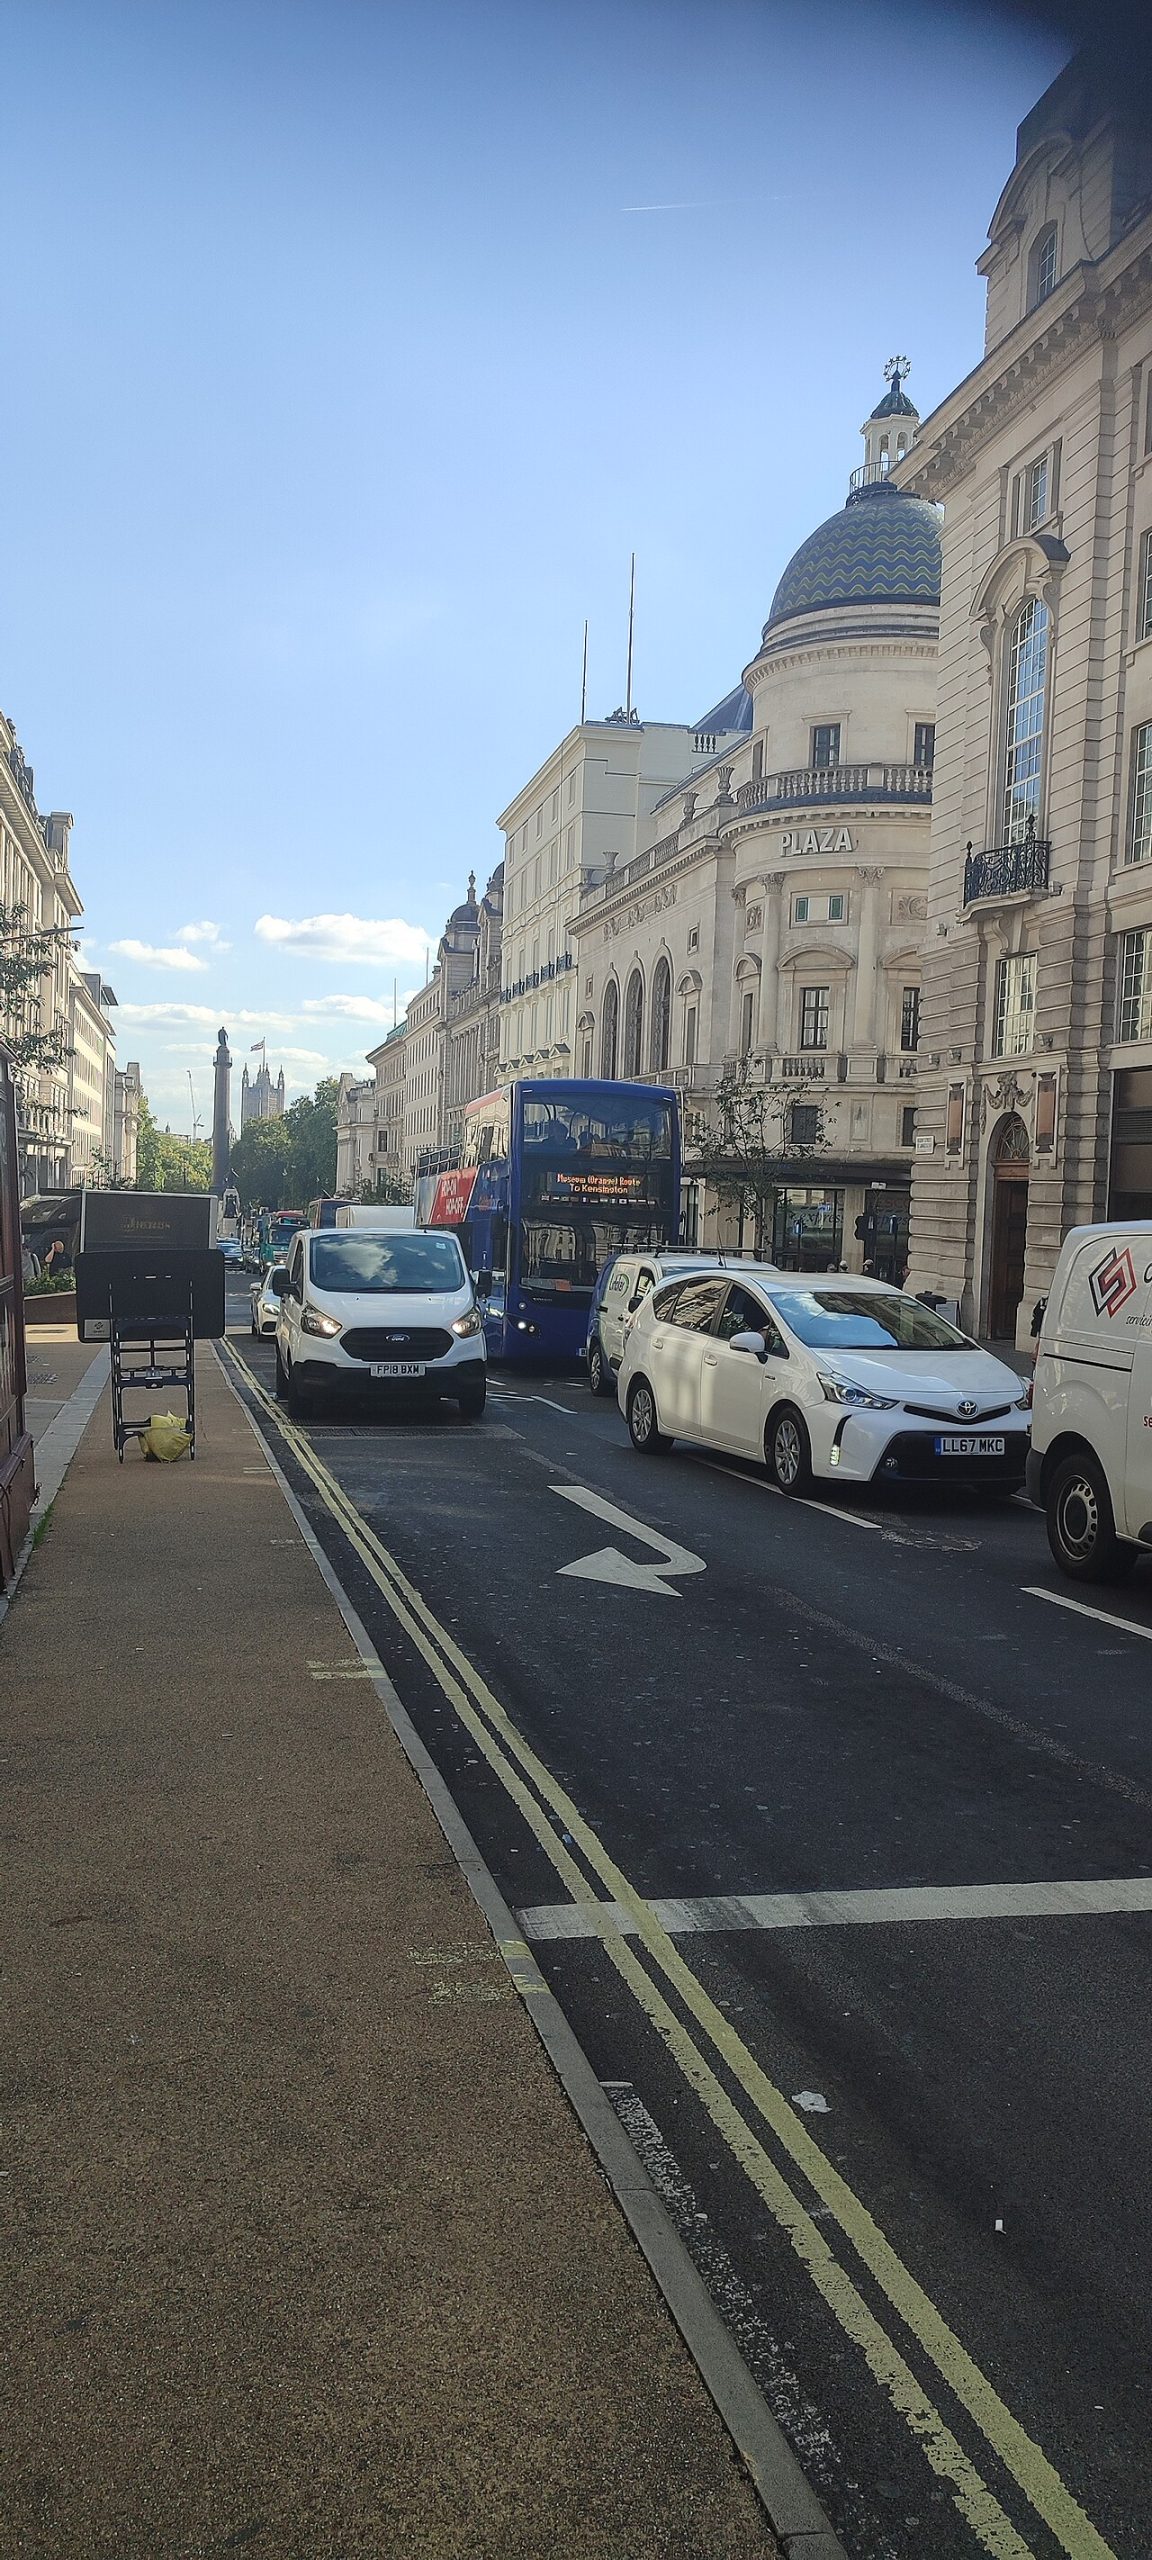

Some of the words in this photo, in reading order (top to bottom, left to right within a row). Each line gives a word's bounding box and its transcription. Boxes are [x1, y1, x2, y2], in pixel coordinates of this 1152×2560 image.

[780, 827, 853, 857] PLAZA
[569, 1183, 581, 1192] To
[582, 1184, 628, 1195] Kensington
[377, 1365, 398, 1375] FP18
[943, 1438, 976, 1453] LL67
[979, 1438, 1003, 1453] MKC
